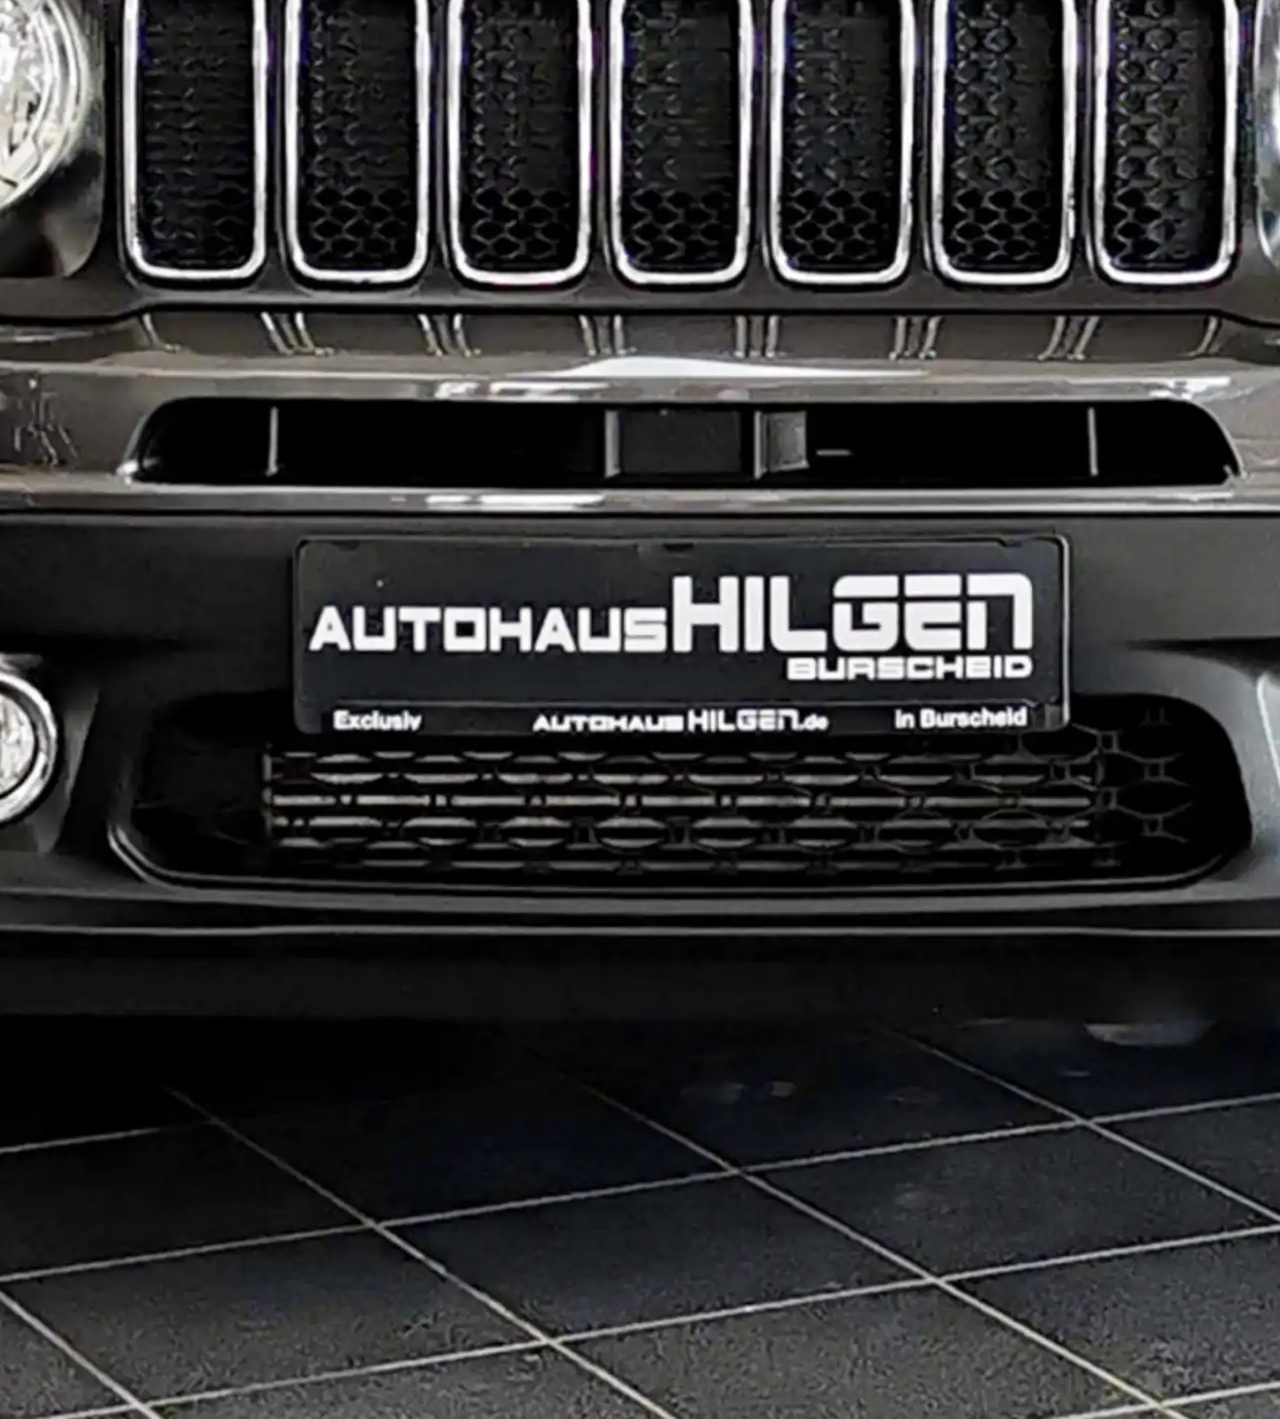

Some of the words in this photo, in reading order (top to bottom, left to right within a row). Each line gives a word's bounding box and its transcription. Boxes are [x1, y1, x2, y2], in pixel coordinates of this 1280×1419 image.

[787, 658, 1032, 681] BURSCHEID
[333, 710, 422, 732] Exclusiv
[895, 709, 915, 729] in
[920, 706, 1028, 729] Burscheid
